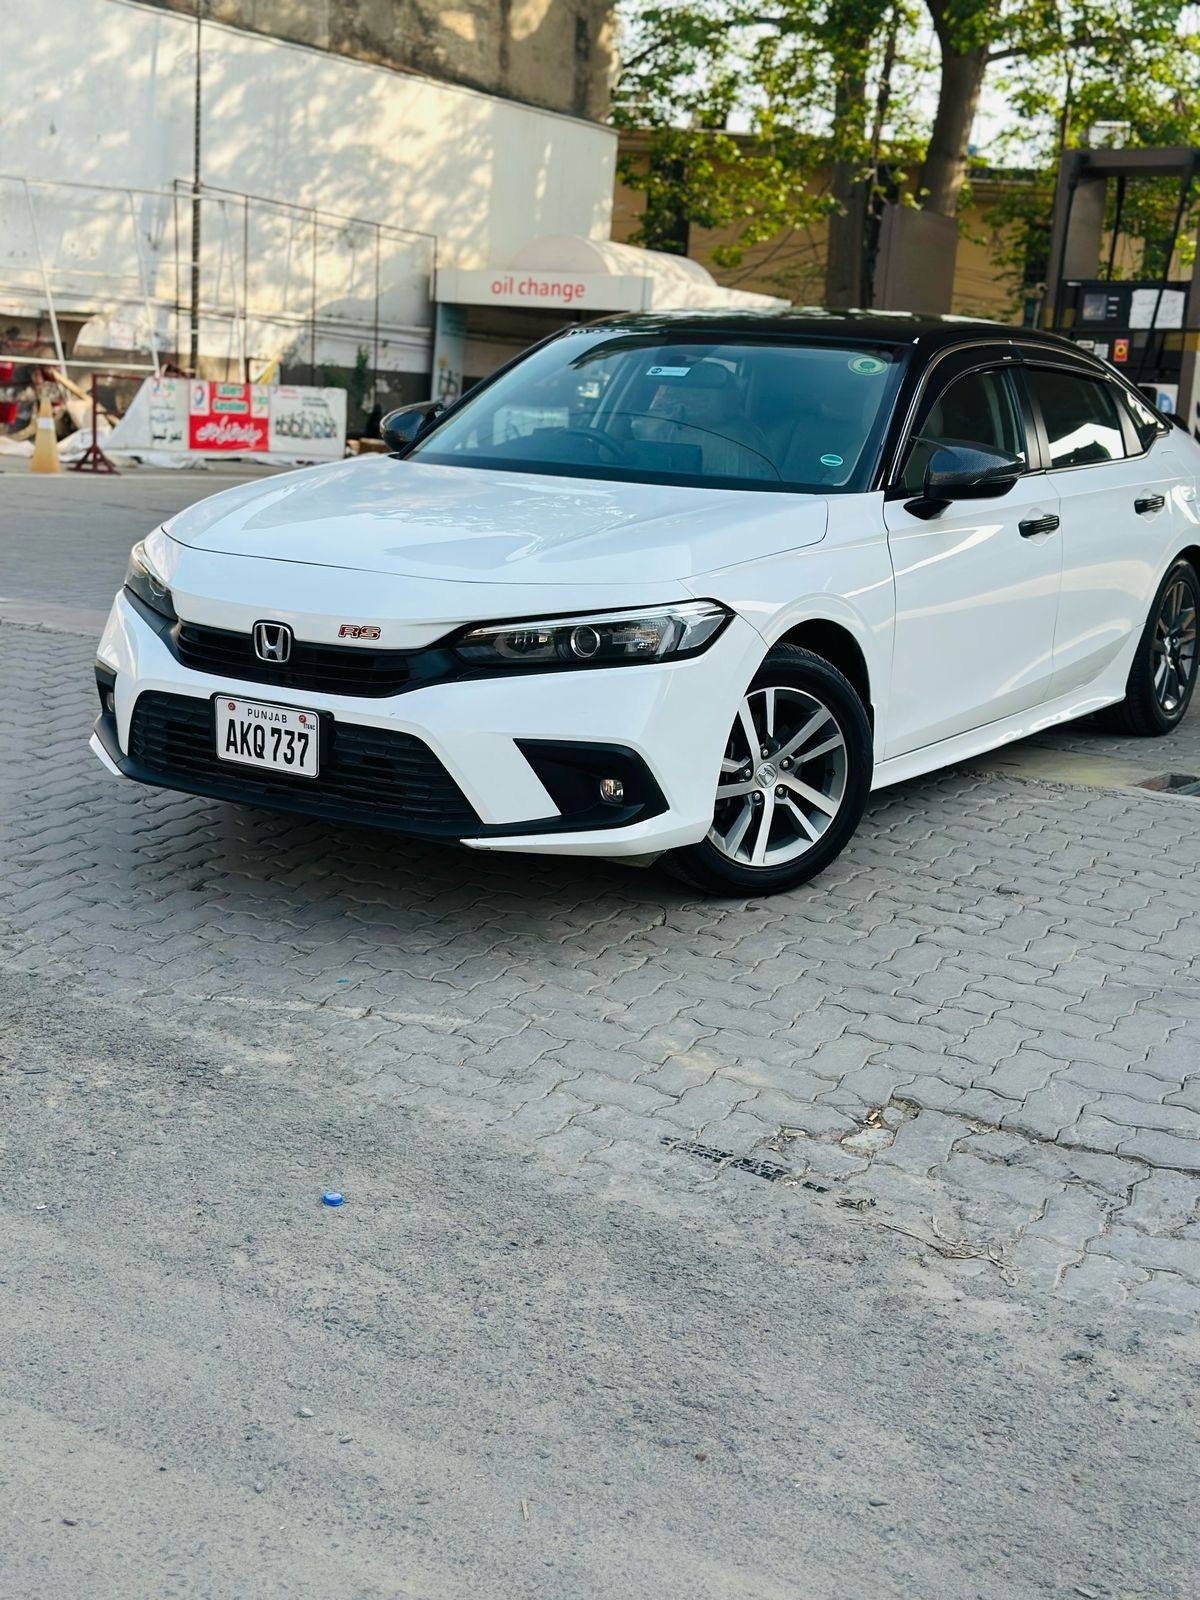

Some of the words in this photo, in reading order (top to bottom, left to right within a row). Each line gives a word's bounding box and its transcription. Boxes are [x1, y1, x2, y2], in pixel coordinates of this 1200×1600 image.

[490, 276, 513, 295] oil
[518, 277, 585, 302] change
[338, 624, 381, 640] RS
[247, 708, 288, 724] PUNJAB
[225, 719, 265, 759] AKQ
[270, 727, 309, 767] 737
